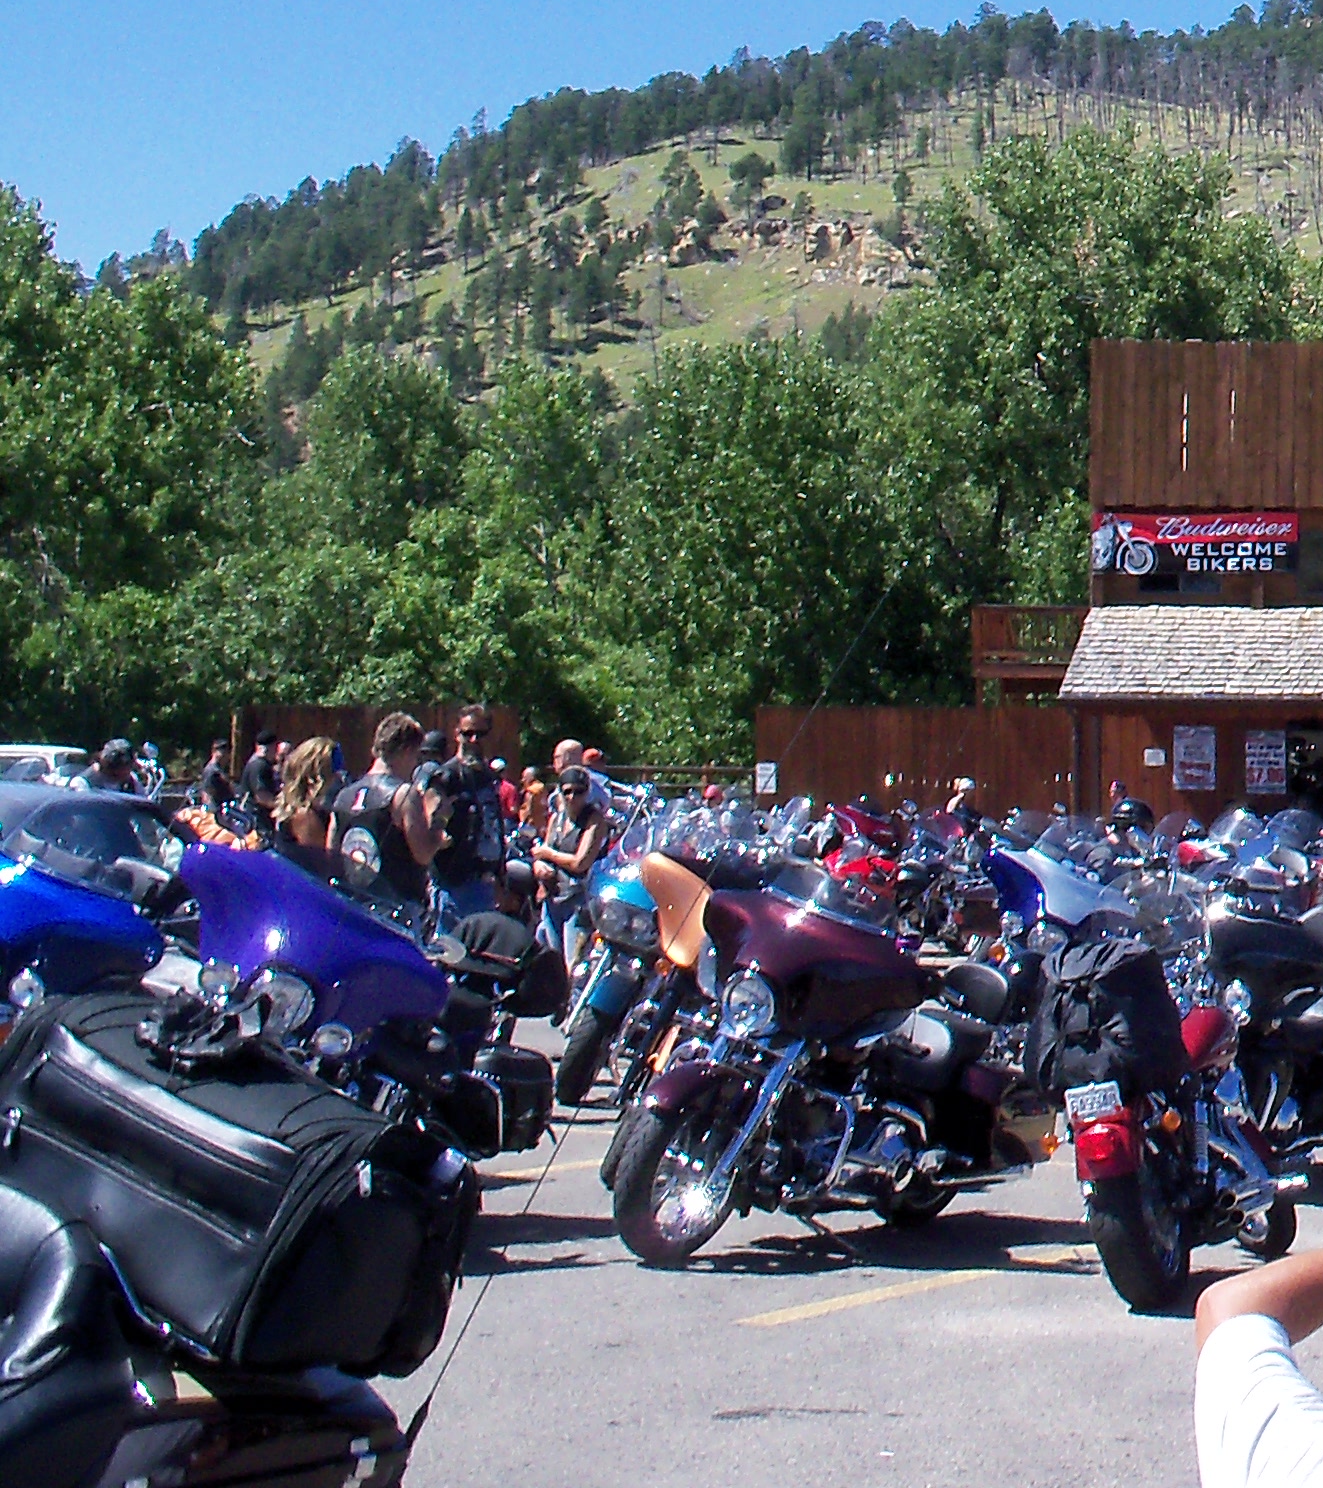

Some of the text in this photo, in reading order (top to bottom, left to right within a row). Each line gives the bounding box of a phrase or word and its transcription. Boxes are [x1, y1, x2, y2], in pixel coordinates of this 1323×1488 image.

[1155, 516, 1293, 540] Budweiser
[1170, 542, 1288, 557] WELCOME
[1186, 557, 1274, 572] BIKERS
